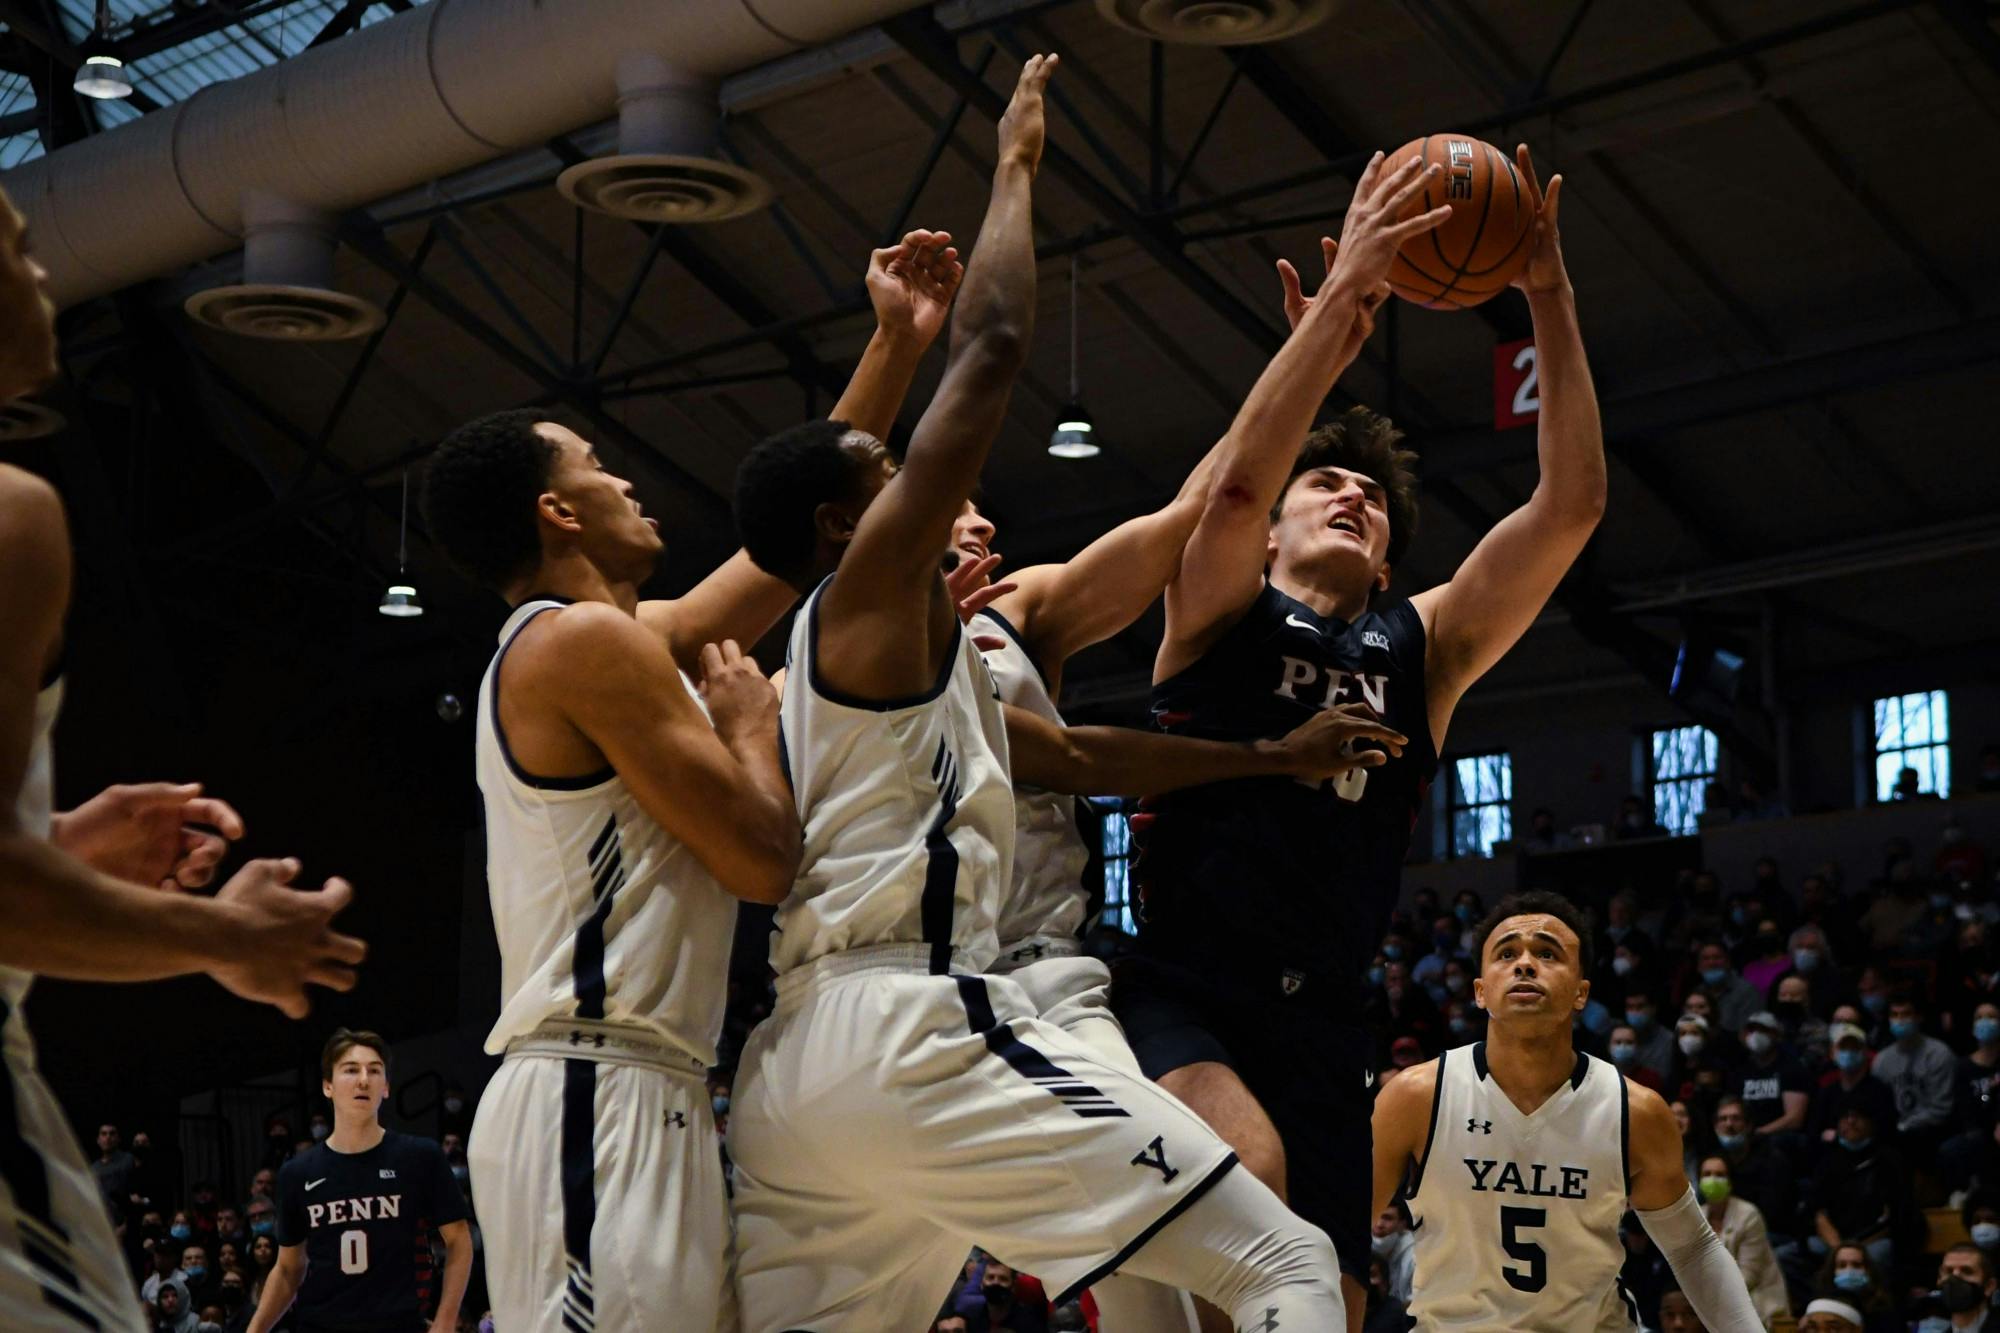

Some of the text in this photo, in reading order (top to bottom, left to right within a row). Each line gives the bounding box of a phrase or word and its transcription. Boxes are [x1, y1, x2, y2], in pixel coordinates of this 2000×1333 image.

[1511, 344, 1539, 415] 2
[1131, 1135, 1179, 1184] Y
[1463, 1158, 1588, 1199] YALE
[306, 1194, 402, 1229] PENN
[340, 1229, 369, 1276] 0
[1501, 1206, 1546, 1293] 5
